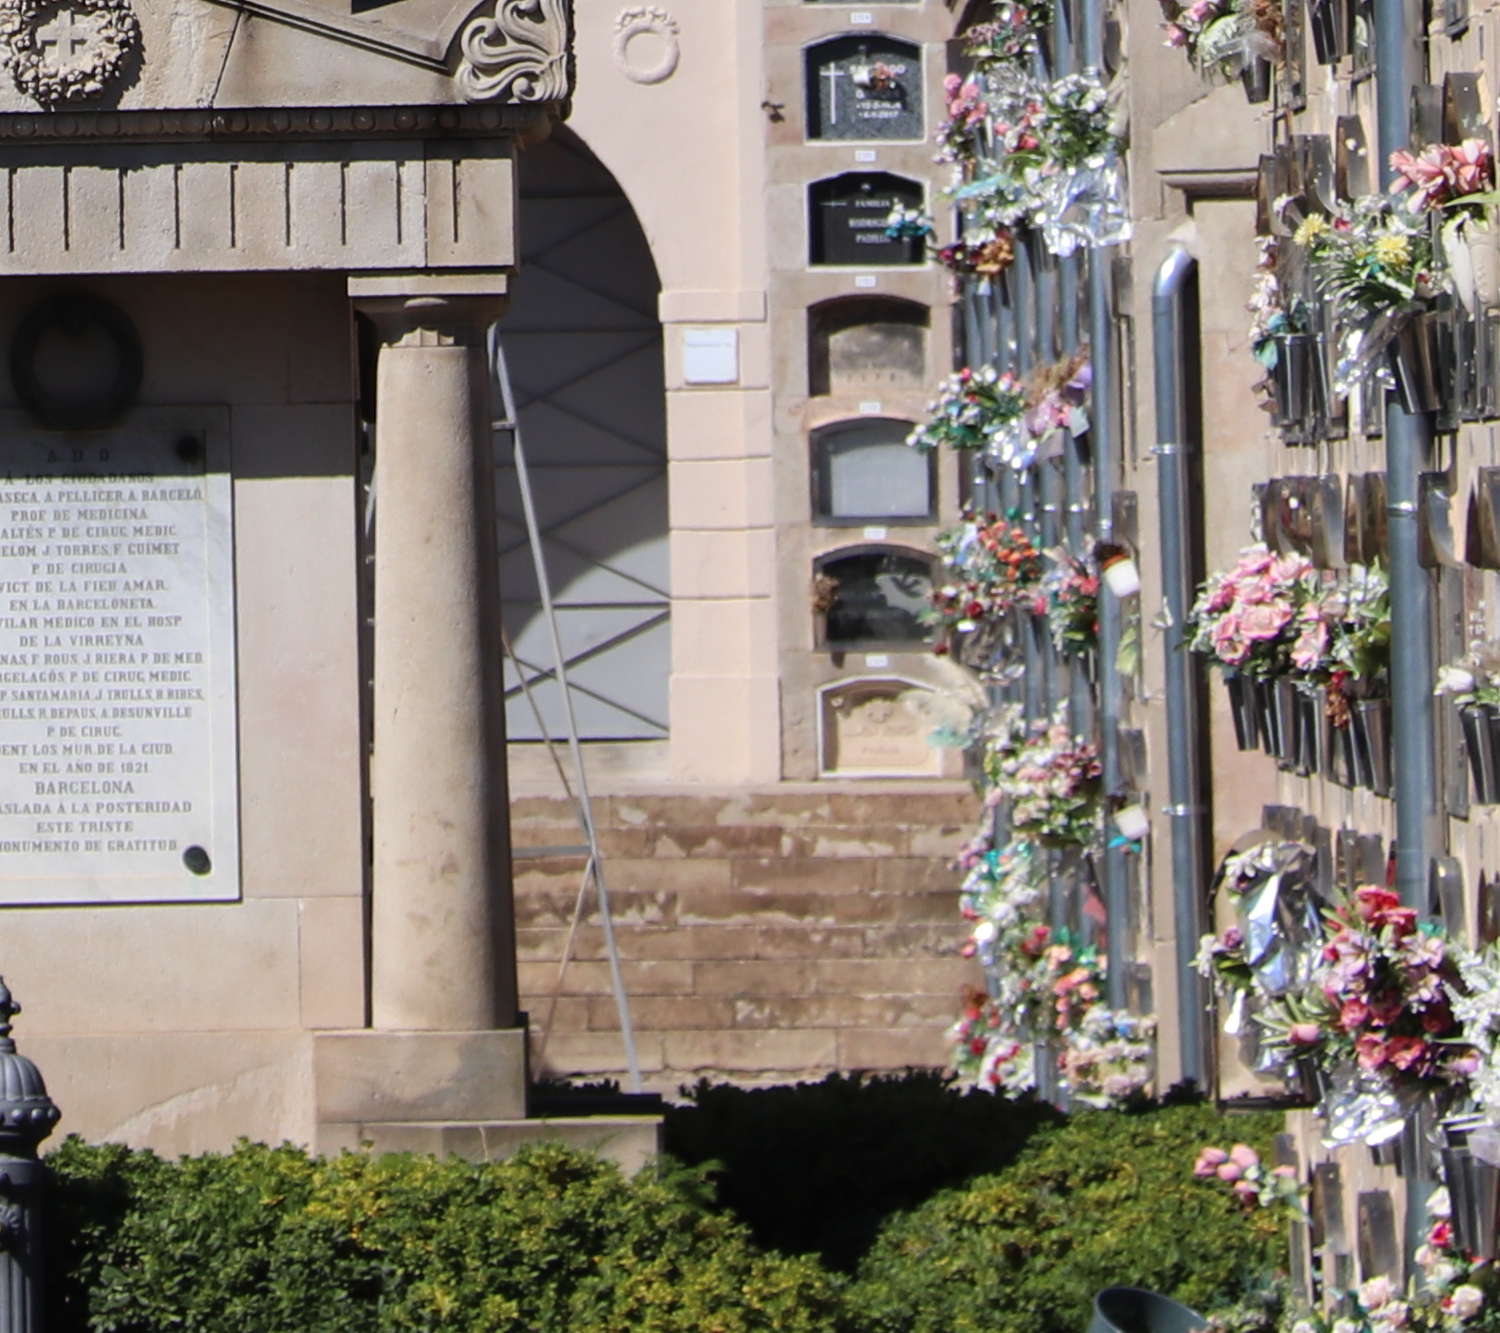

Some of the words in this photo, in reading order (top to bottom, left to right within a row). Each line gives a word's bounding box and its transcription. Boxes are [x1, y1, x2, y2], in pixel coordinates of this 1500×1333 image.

[26, 472, 53, 484] LOS
[53, 509, 70, 521] DE
[77, 508, 148, 520] MEDICINA
[62, 527, 79, 538] DE
[47, 563, 64, 575] DE
[35, 580, 52, 593] DE
[60, 580, 77, 592] LA
[9, 599, 27, 611] EN
[33, 599, 50, 611] LA
[101, 616, 118, 628] EN
[125, 616, 142, 628] EL
[19, 635, 38, 647] DE
[44, 635, 62, 647] LA
[70, 634, 144, 647] VIRREYNA
[153, 652, 170, 664] DE
[83, 671, 99, 683] DE
[60, 726, 76, 738] DE
[33, 744, 57, 756] LOS
[98, 743, 114, 755] DE
[119, 743, 136, 755] LA
[19, 762, 37, 774] EN
[43, 762, 60, 774] EL
[66, 758, 92, 774] AÑO
[98, 762, 114, 774] DE
[34, 780, 135, 795] BARCELONA
[71, 802, 90, 815] LA
[95, 800, 192, 813] POSTERIDAD
[36, 821, 73, 833] ESTE
[79, 820, 134, 833] TRISTE
[85, 840, 102, 852] DE
